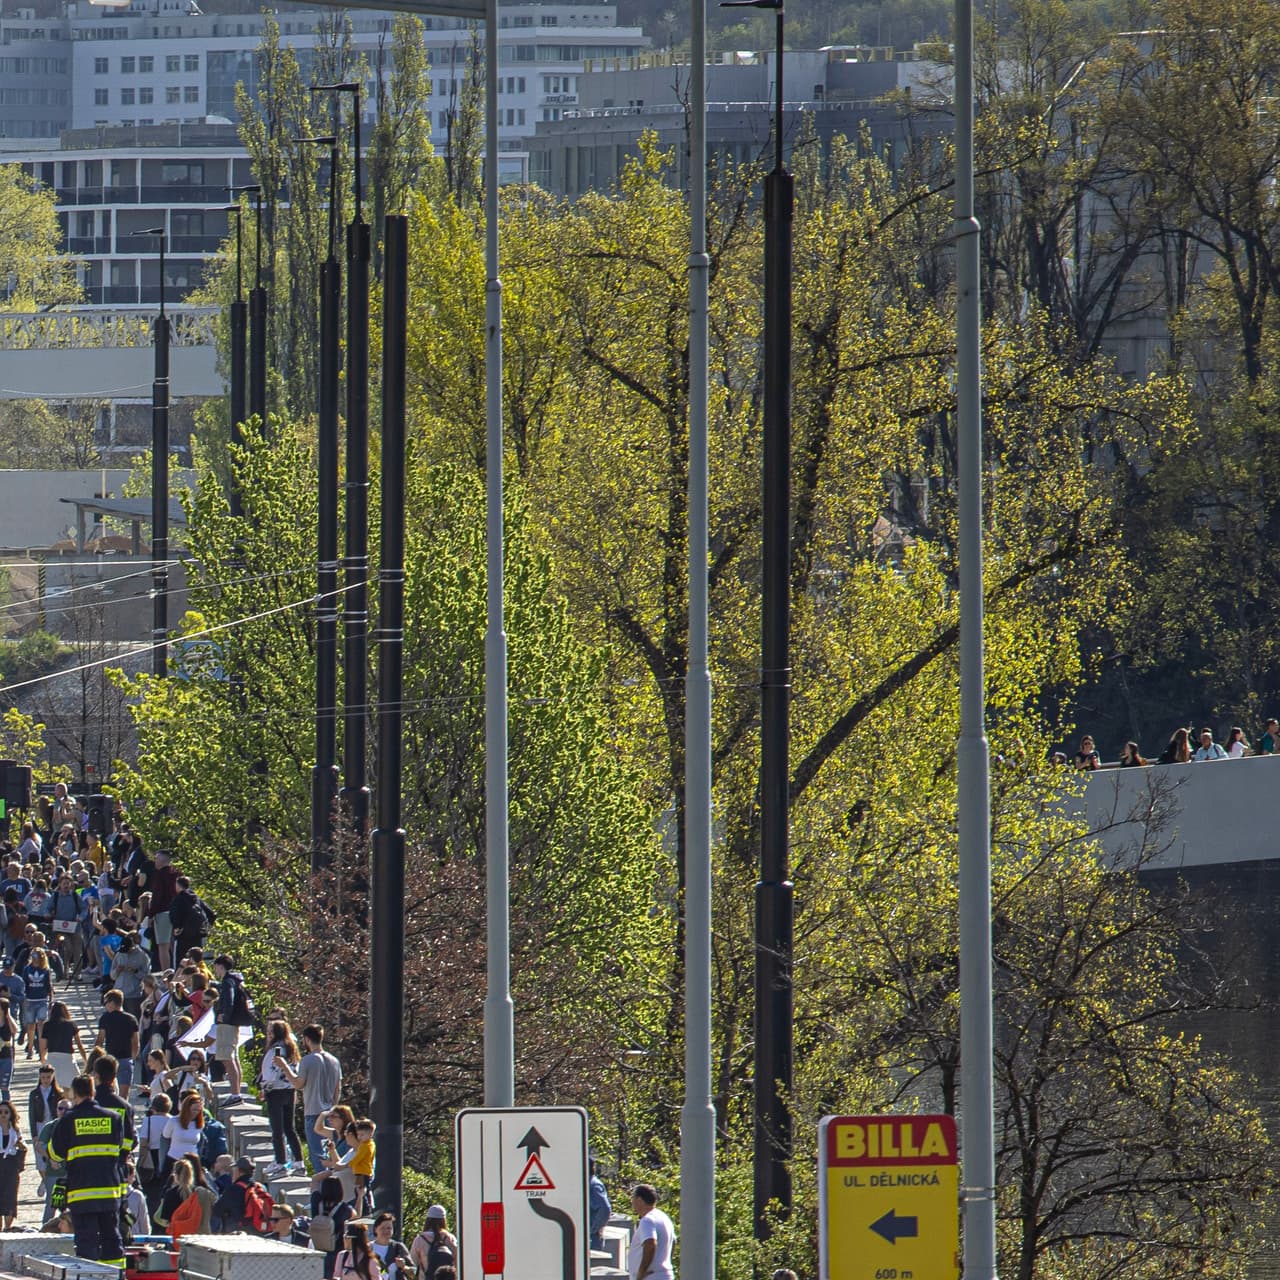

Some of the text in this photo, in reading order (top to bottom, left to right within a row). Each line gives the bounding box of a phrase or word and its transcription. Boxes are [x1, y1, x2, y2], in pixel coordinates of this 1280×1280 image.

[836, 1123, 949, 1158] BILLA
[844, 1170, 940, 1187] UL. DĚLNICKÁ
[875, 1269, 913, 1280] 600 m
